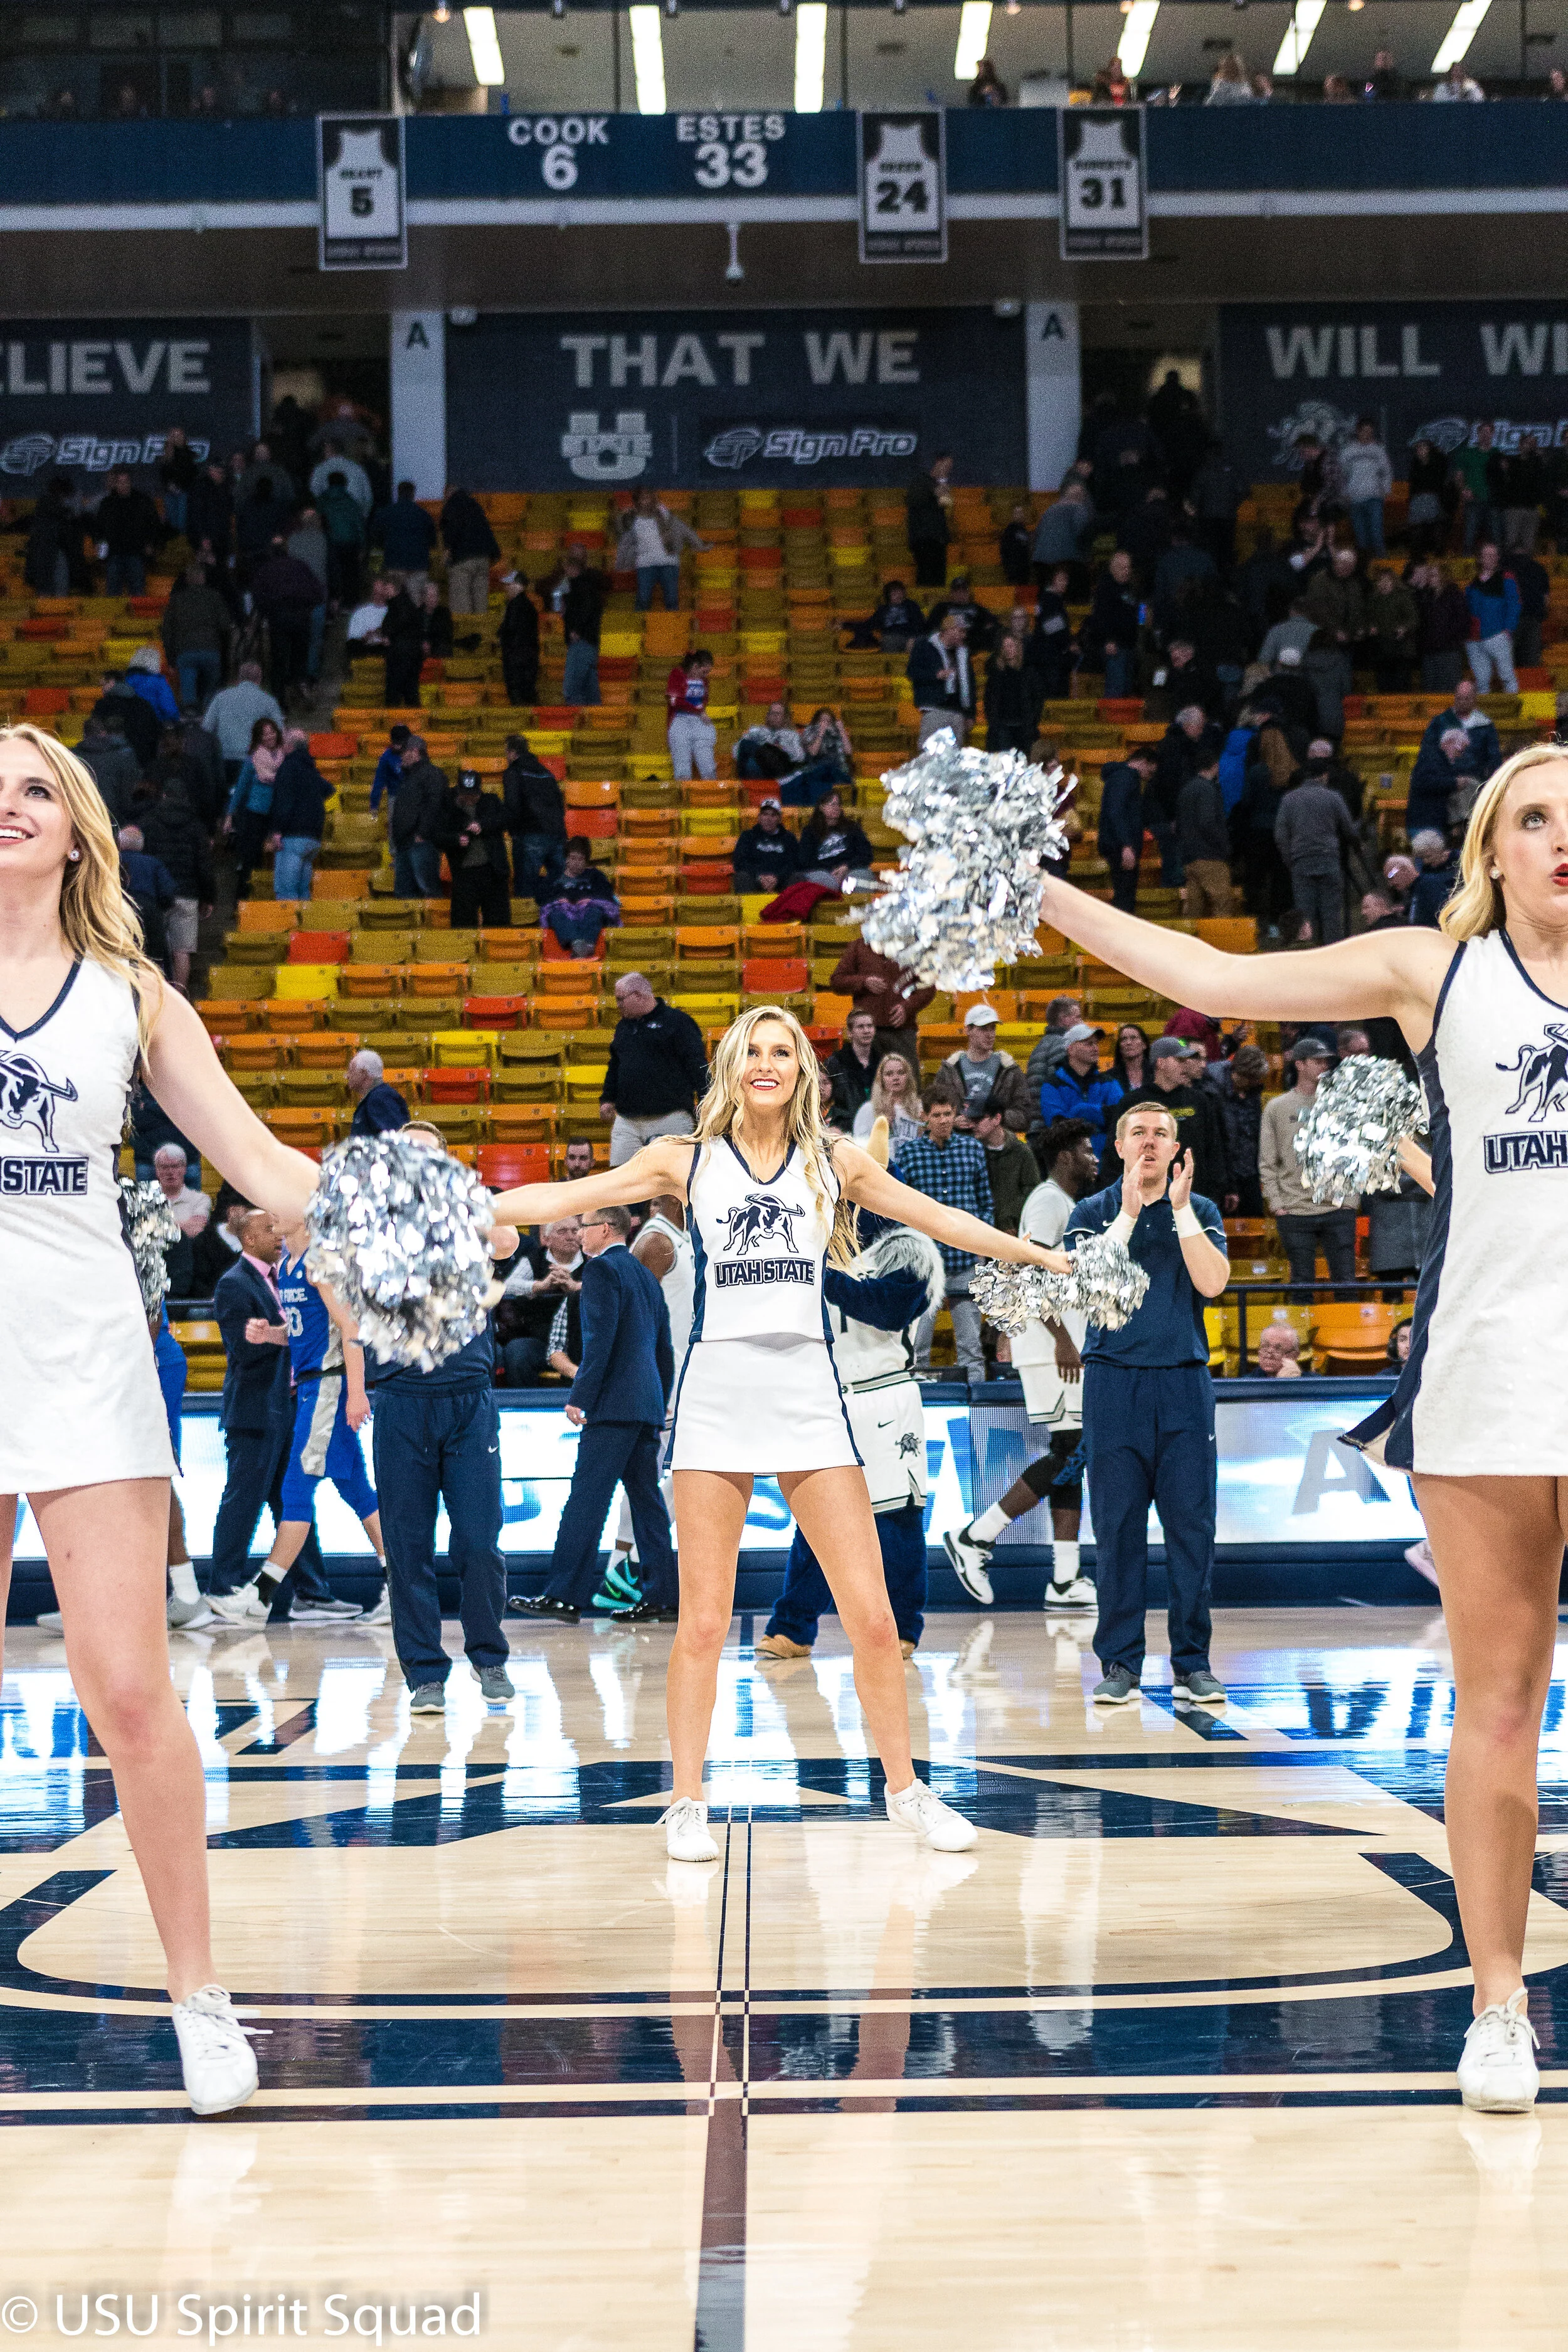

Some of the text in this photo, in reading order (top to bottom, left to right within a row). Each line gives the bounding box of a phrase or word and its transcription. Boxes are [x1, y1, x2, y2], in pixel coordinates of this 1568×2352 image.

[508, 118, 610, 146] COOK
[675, 115, 787, 141] ESTES
[541, 145, 578, 190] 6
[694, 143, 769, 188] 33
[350, 186, 374, 217] 5
[877, 179, 929, 213] 24
[1080, 177, 1125, 209] 31
[406, 320, 429, 349] A
[1041, 313, 1065, 340] A
[561, 331, 920, 387] THAT WE
[1265, 323, 1441, 377] WILL
[0, 342, 210, 395] LIEVE
[1484, 1131, 1568, 1173] UTAH
[1, 1157, 88, 1195] STATE
[714, 1258, 815, 1288] UTAH STATE
